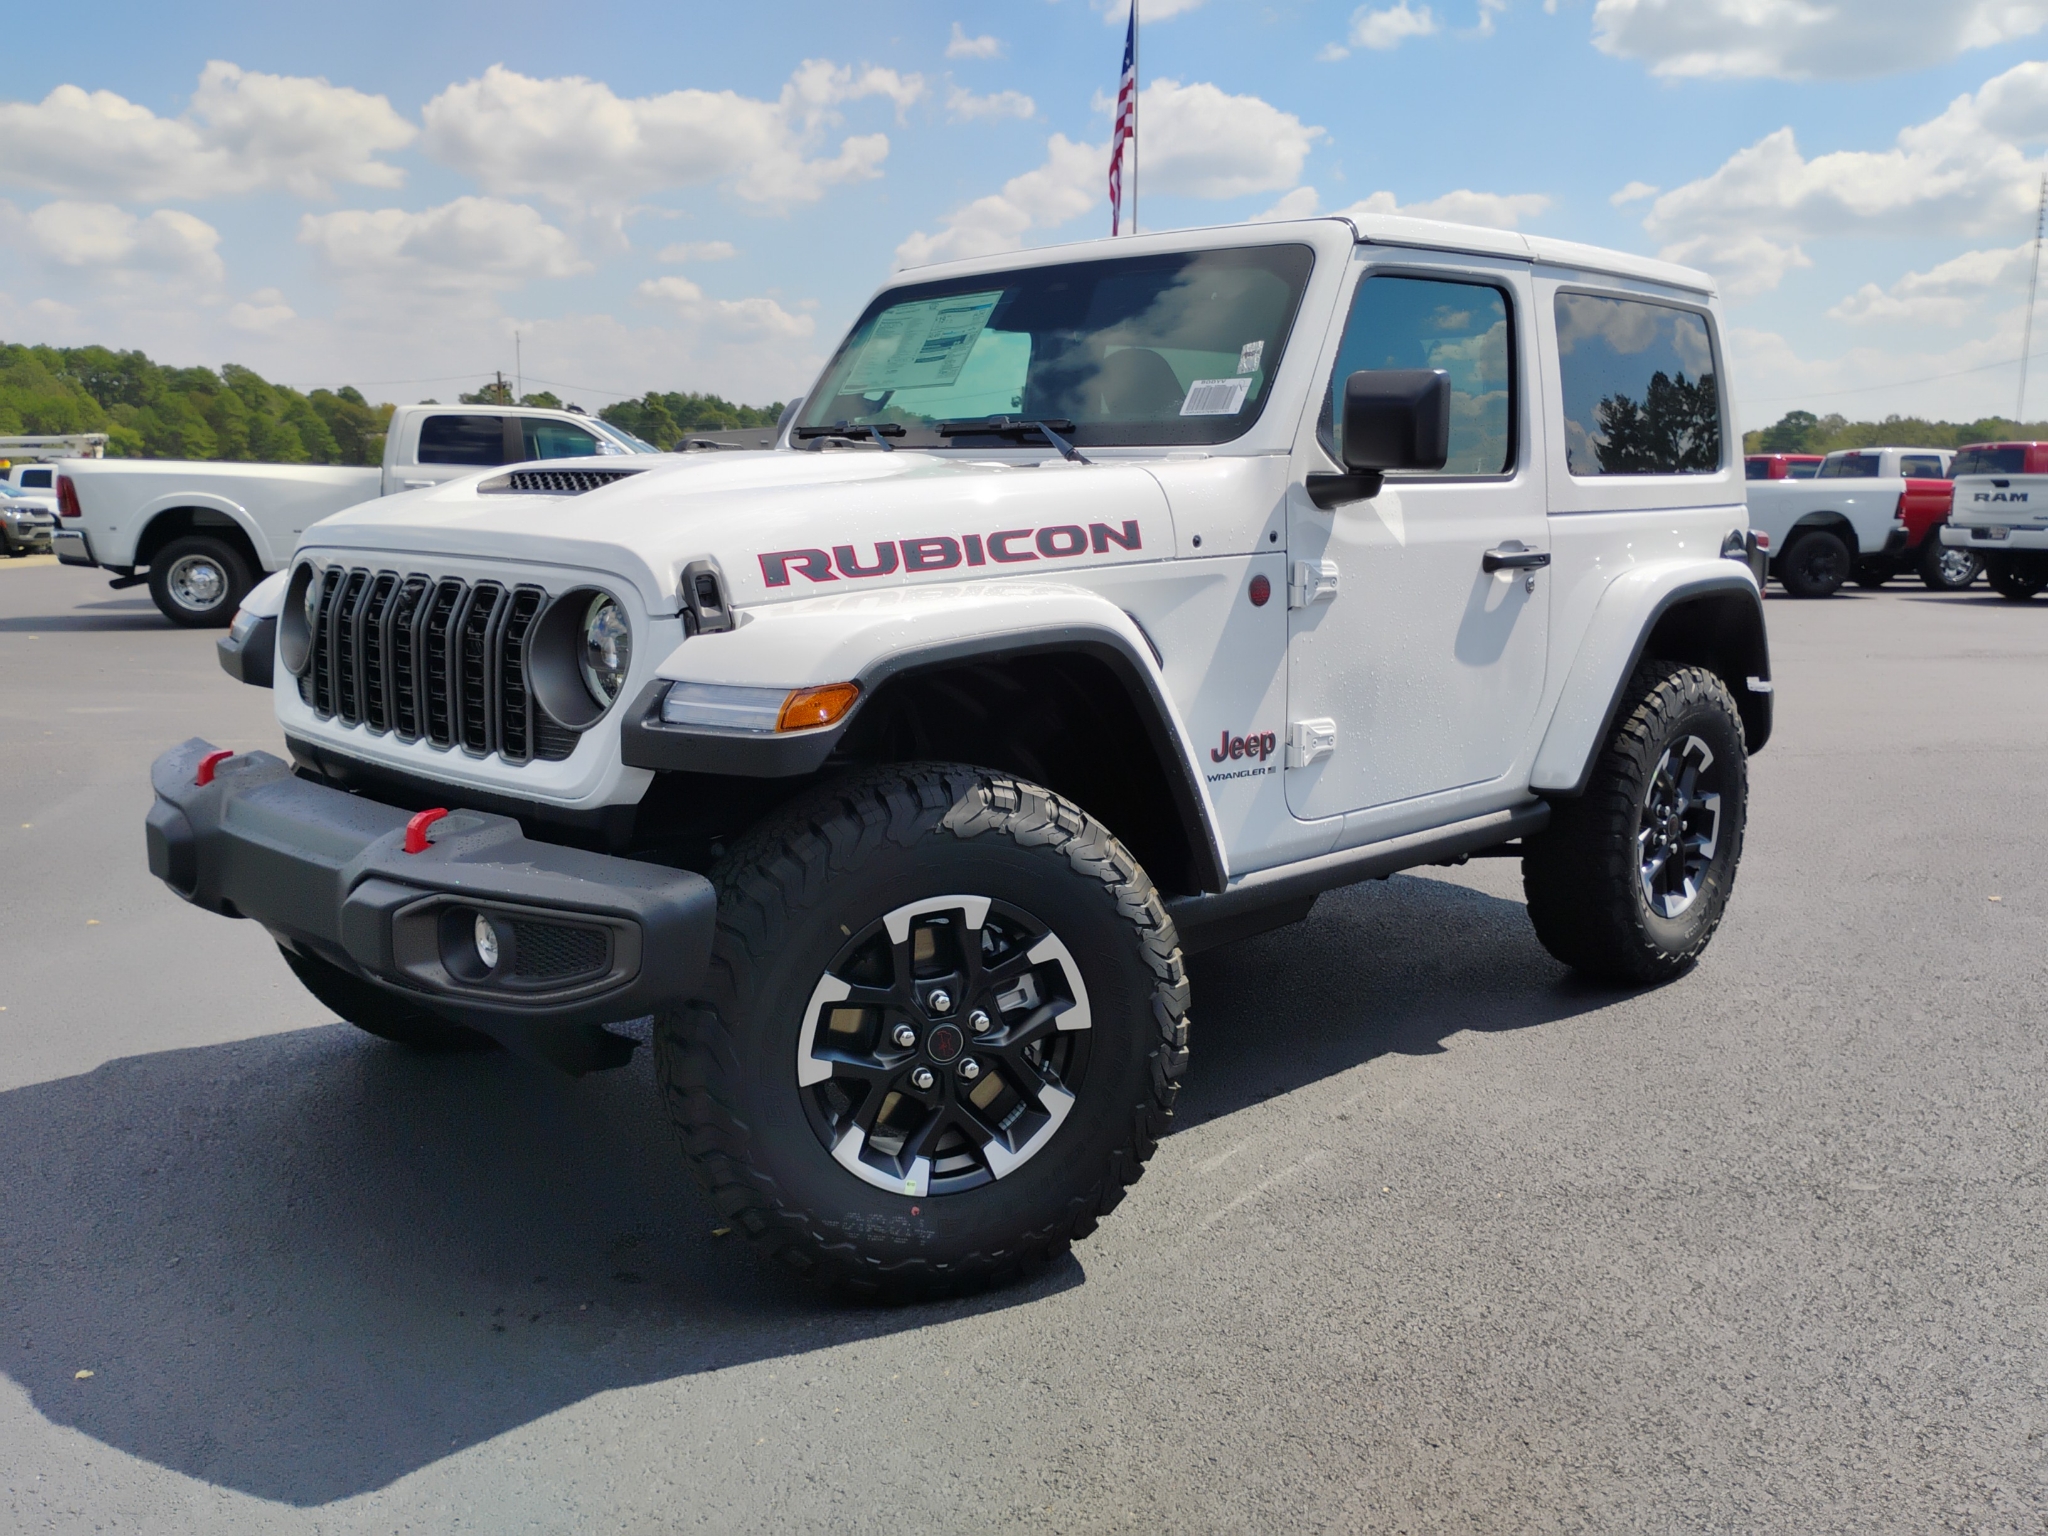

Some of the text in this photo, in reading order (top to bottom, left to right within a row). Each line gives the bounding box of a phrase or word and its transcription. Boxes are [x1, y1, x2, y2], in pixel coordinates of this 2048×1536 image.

[1973, 492, 2029, 502] RAM
[757, 520, 1142, 588] RUBICON
[1210, 730, 1277, 764] Jeep
[1206, 766, 1266, 783] WRANGLER
